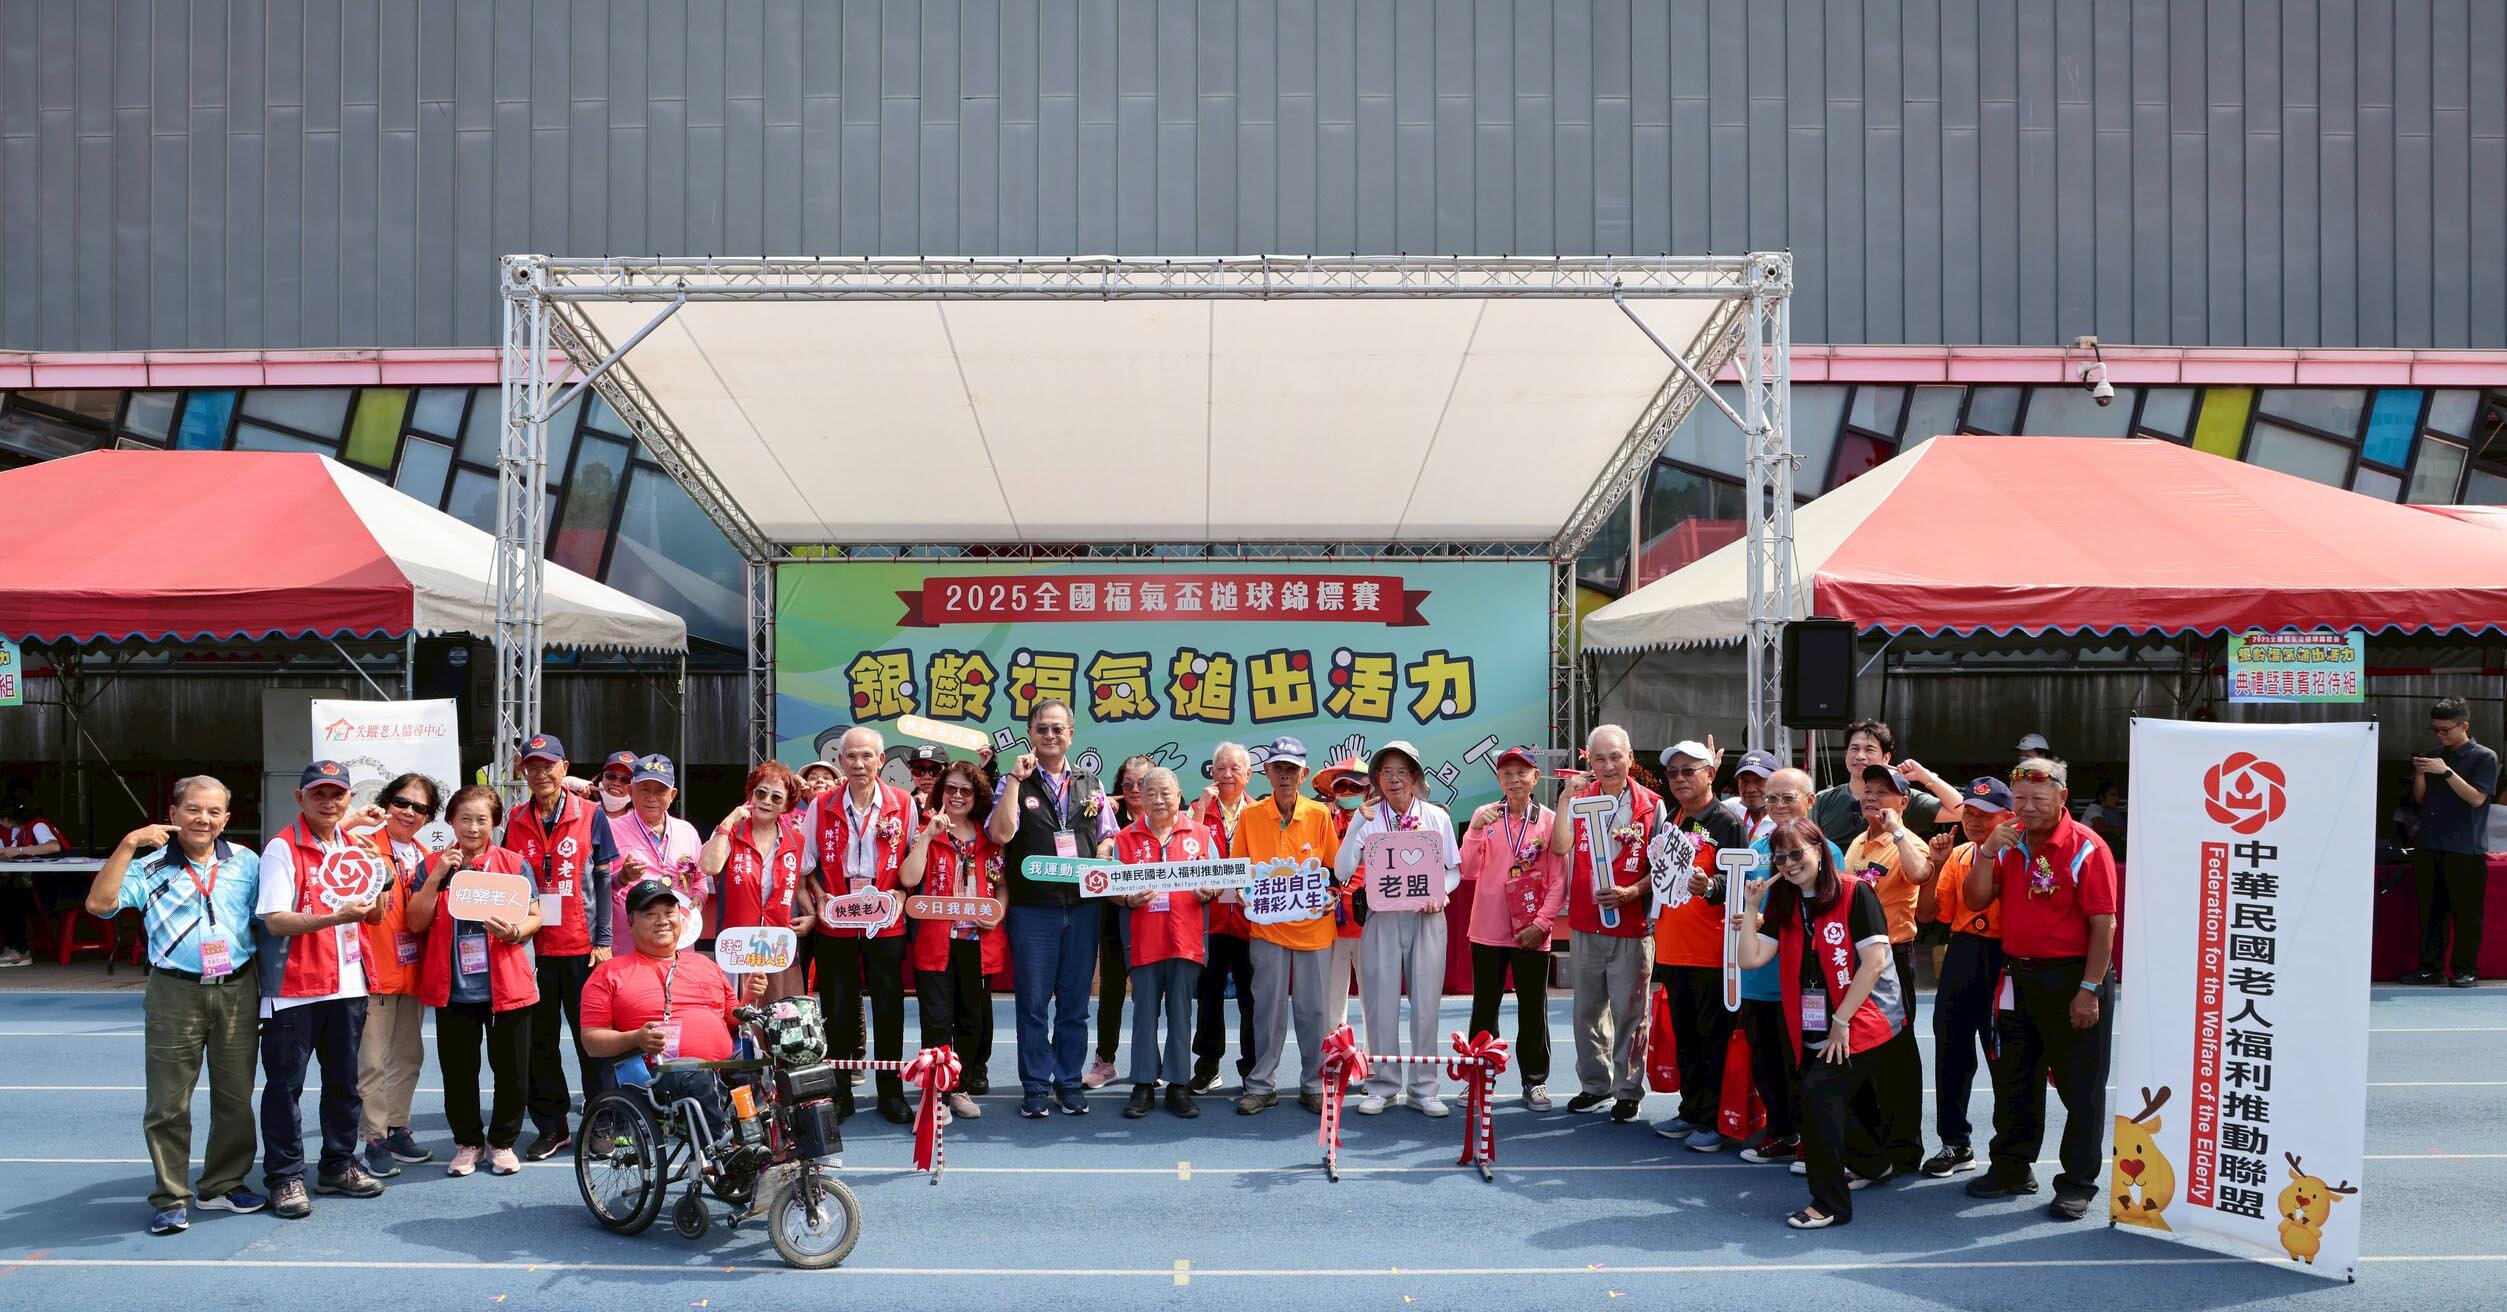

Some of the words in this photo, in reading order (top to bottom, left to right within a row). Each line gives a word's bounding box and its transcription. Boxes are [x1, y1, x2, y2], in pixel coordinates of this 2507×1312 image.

[945, 581, 1381, 613] 2025全國福氣盃槌球錦標賽
[844, 646, 1476, 725] 銀齡福氣槌出活力
[2235, 670, 2357, 696] 典禮暨貴賓招待組
[355, 723, 446, 738] 失蹤老人協尋中心
[1385, 848, 1395, 870] I
[557, 861, 575, 897] 老盟
[1110, 863, 1246, 883] 中華民國老人福利推動聯盟
[1112, 884, 1146, 892] Federation
[1174, 880, 1197, 888] Welfare
[1223, 876, 1246, 886] Elderly
[1253, 873, 1322, 896] 活出自己
[455, 887, 523, 908] 快樂老人
[1379, 874, 1430, 899] 老盟
[2206, 846, 2225, 942] Federation
[835, 901, 886, 918] 快樂老人
[915, 901, 993, 917] 今日我最美
[1253, 892, 1322, 915] 精彩人生
[2204, 946, 2221, 973] for
[2203, 976, 2220, 1005] the
[2216, 840, 2279, 1220] 中華民國老人福利推動聯盟
[2200, 1010, 2220, 1077] Welfare
[2199, 1082, 2216, 1103] of
[2198, 1104, 2215, 1133] the
[2191, 1137, 2213, 1201] Elderly
